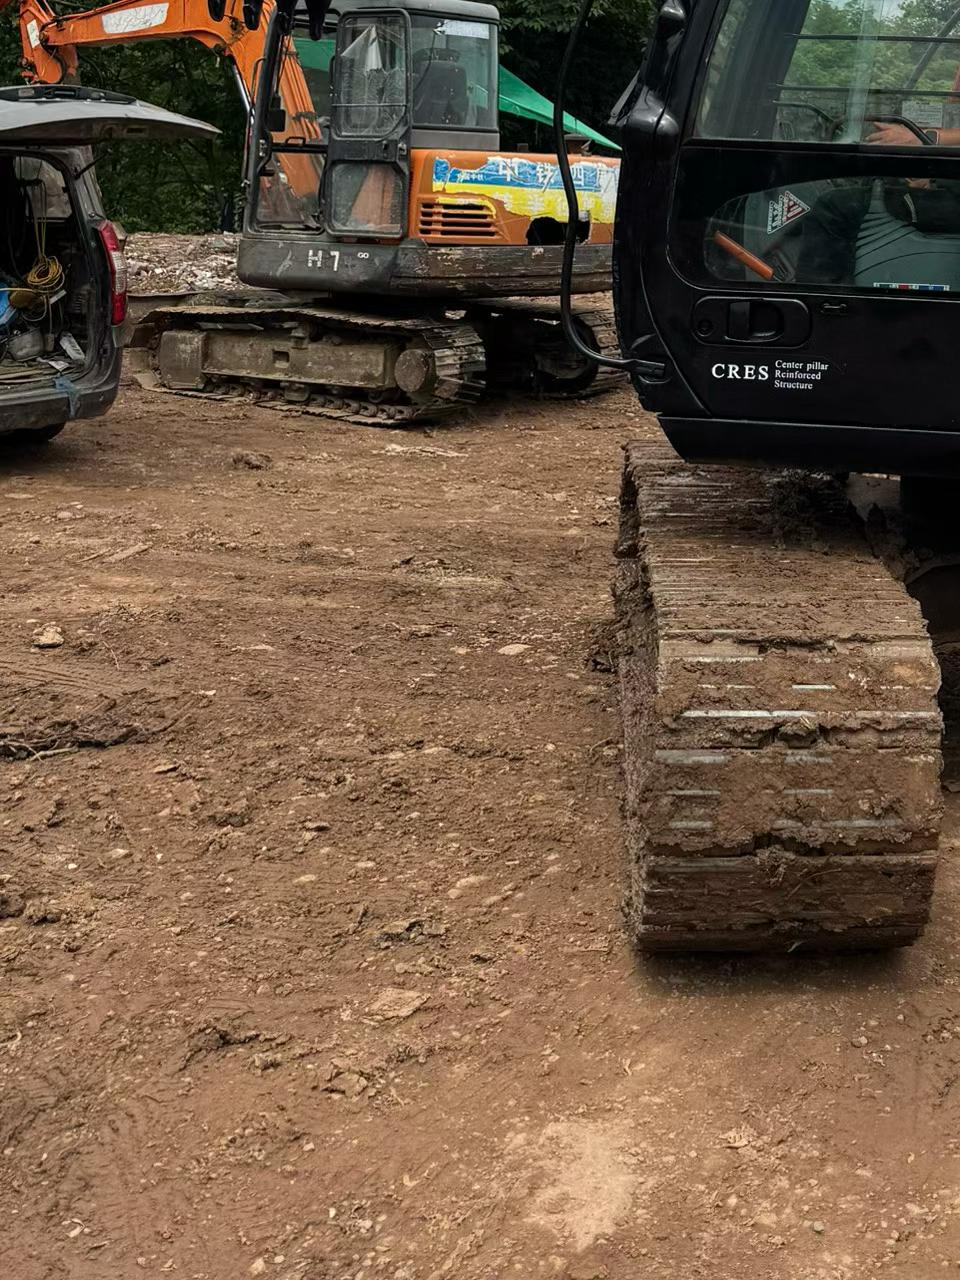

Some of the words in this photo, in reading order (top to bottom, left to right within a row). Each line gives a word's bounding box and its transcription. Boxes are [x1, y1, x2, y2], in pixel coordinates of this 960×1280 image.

[775, 360, 804, 369] Center
[806, 361, 829, 371] pillar
[711, 363, 769, 380] CRES
[775, 370, 821, 380] Reinforced
[774, 380, 813, 390] Structure
